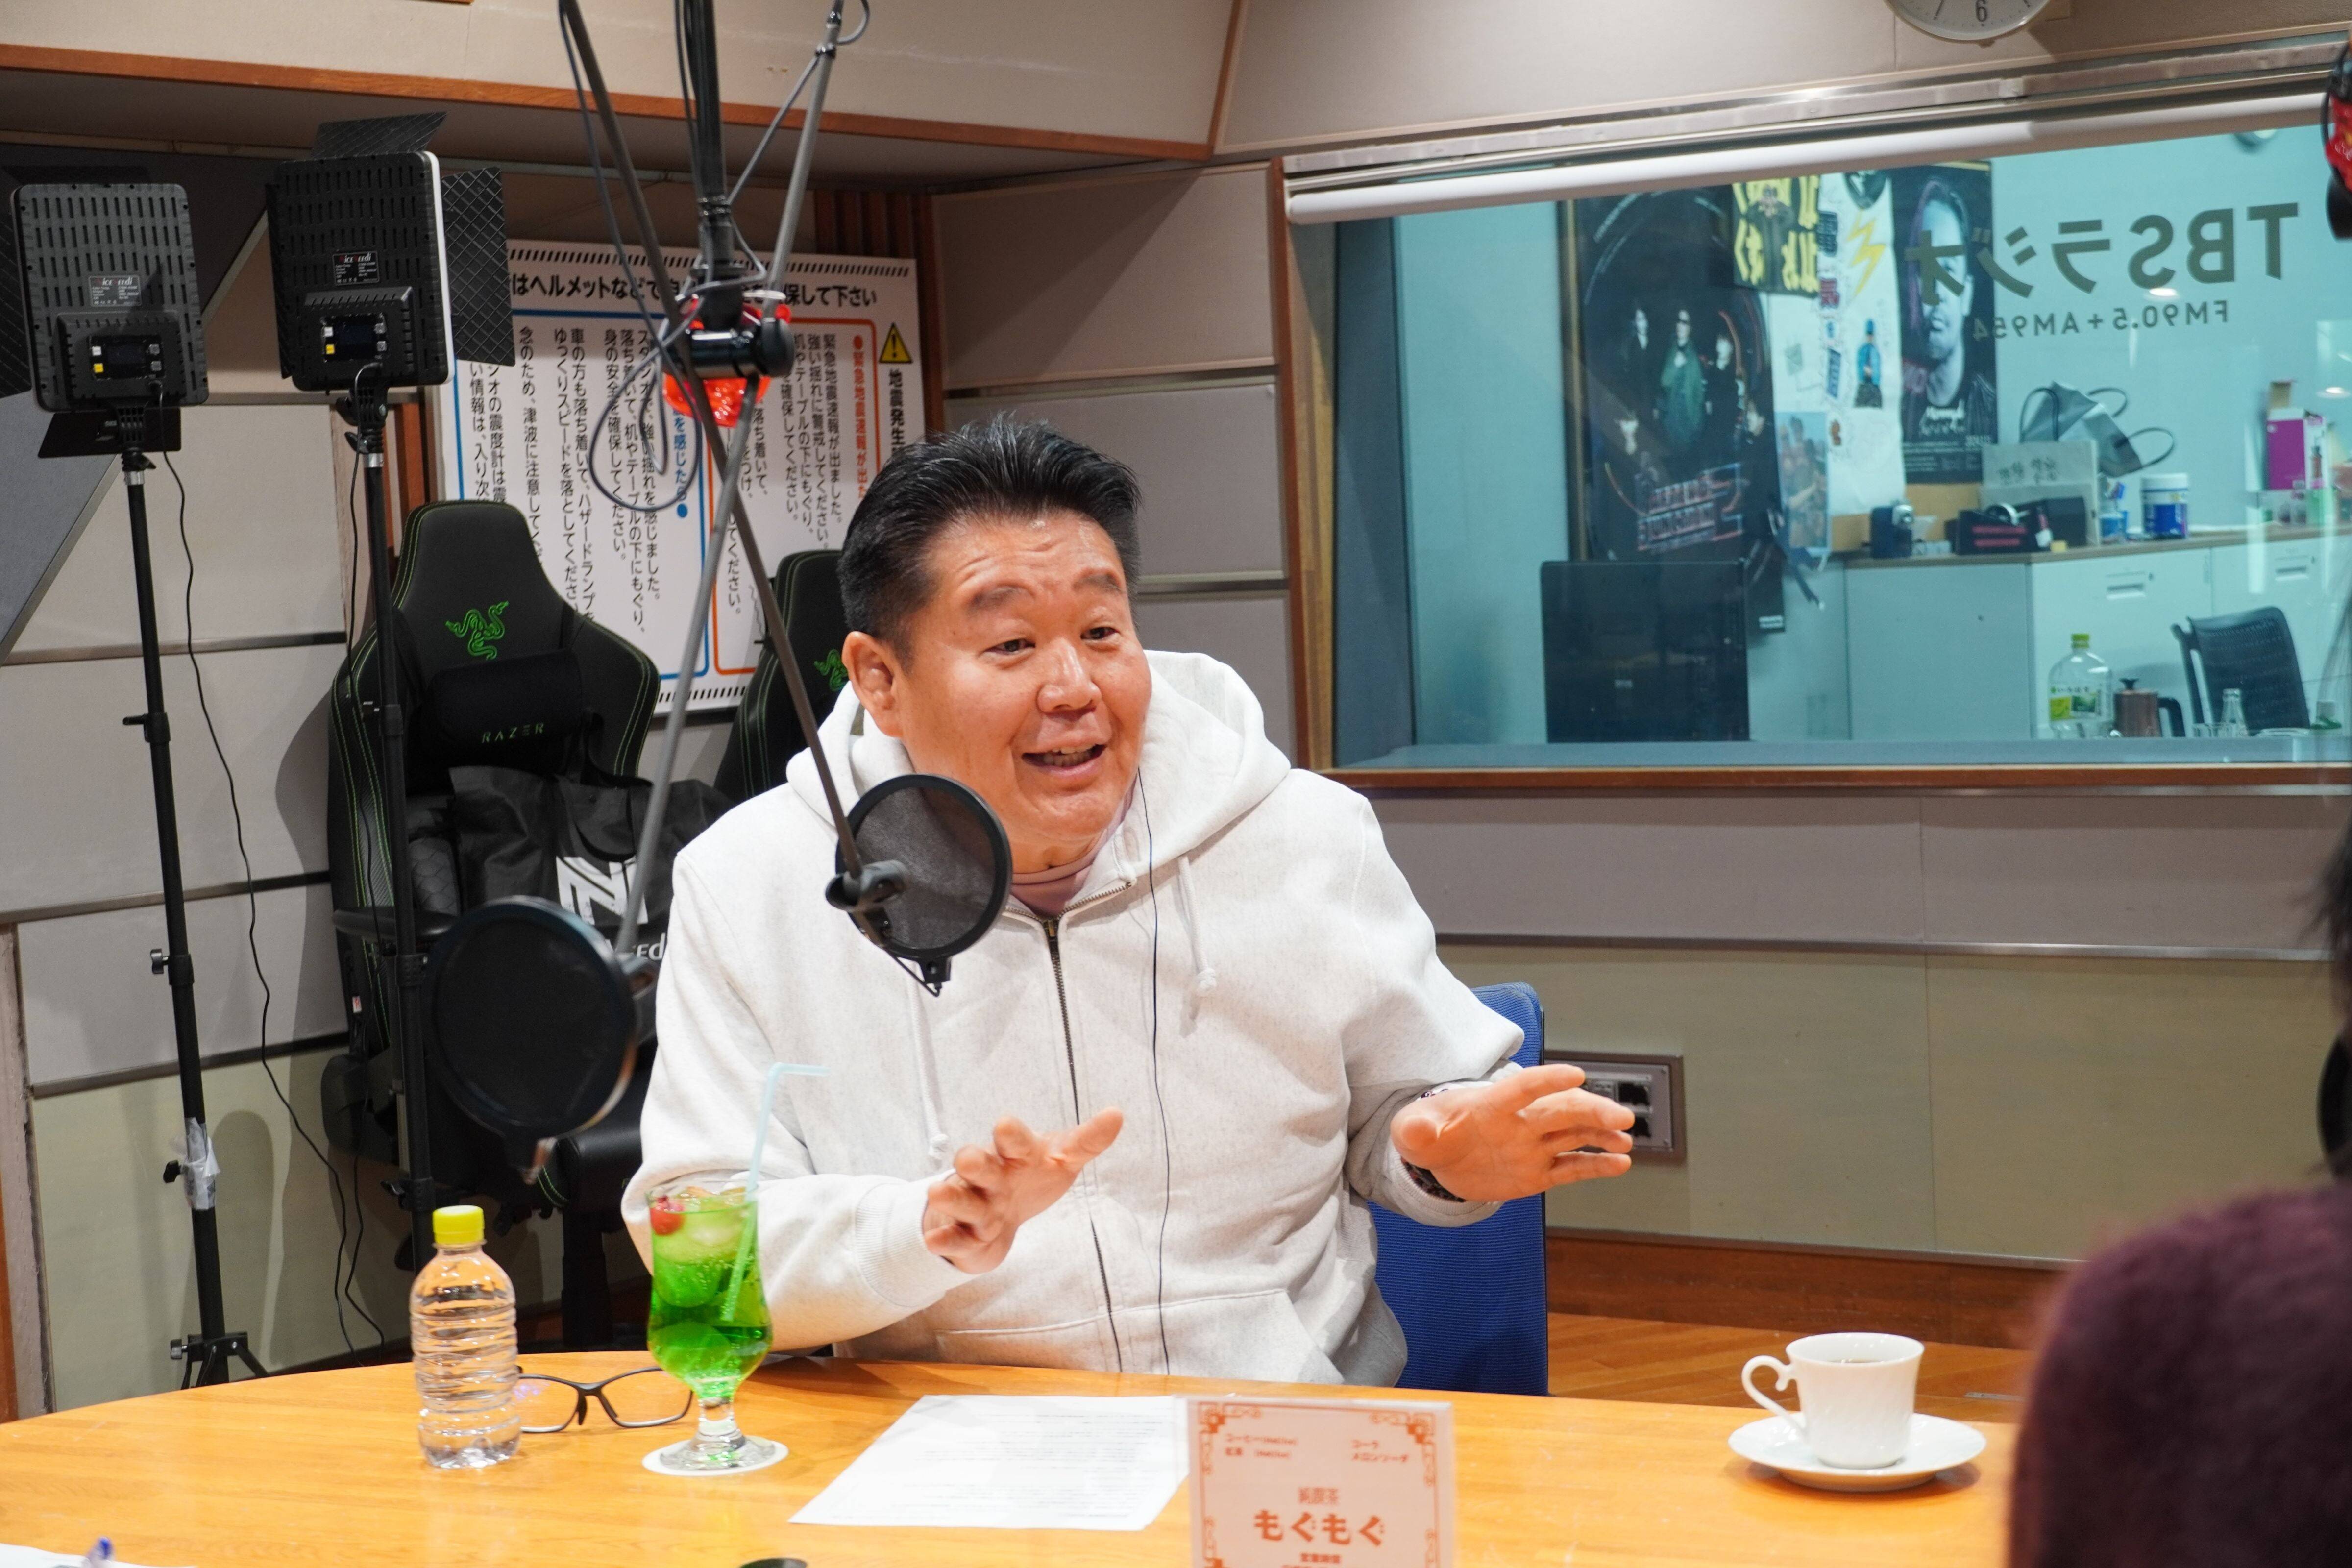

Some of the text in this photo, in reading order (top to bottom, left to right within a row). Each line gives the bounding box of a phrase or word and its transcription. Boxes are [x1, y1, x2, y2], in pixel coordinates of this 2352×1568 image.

[1976, 0, 1988, 22] 6
[470, 363, 490, 501] い情報は、入り次
[808, 334, 829, 549] 強い揺れに警戒してください。
[889, 368, 905, 452] 地震発生
[554, 328, 579, 612] ゆっくりスピードを落としてくださ
[672, 410, 687, 501] を感じたら
[482, 722, 545, 744] RAZER
[1254, 1509, 1386, 1547] もぐもぐ
